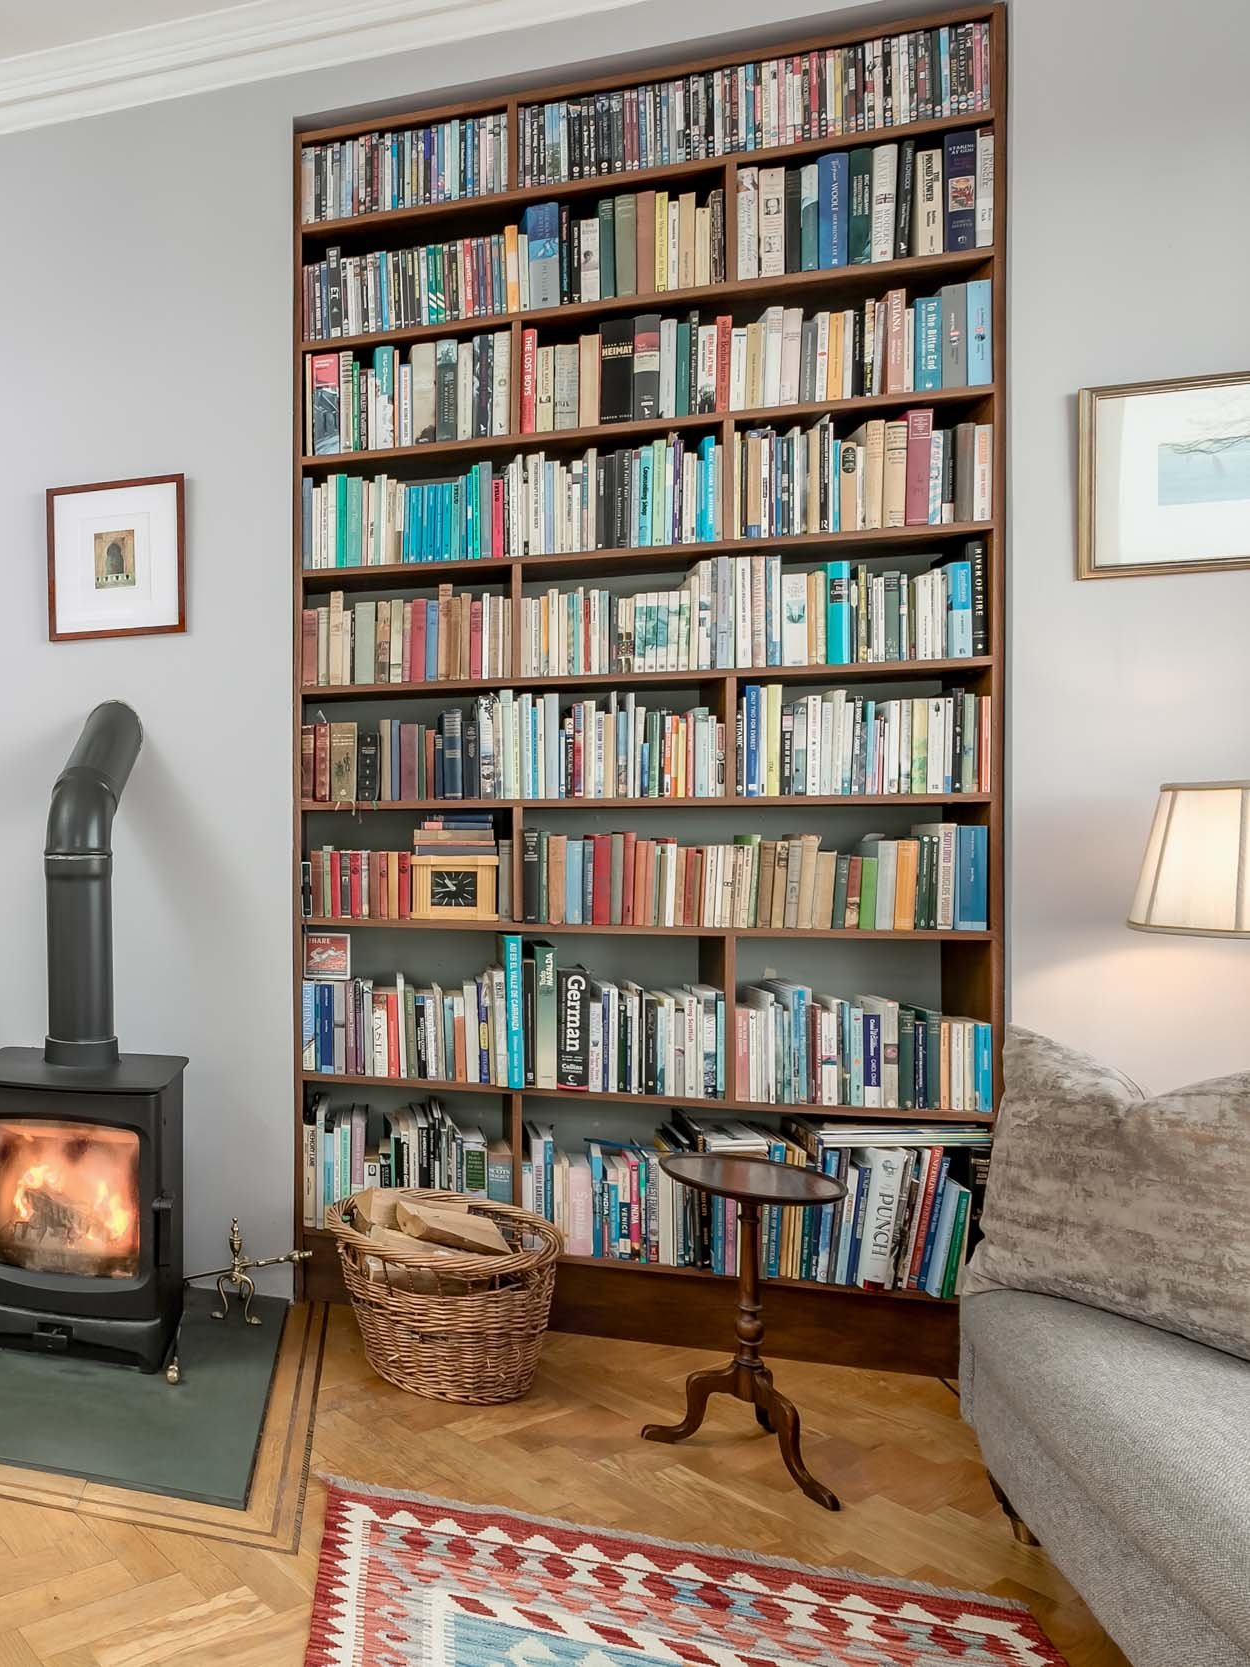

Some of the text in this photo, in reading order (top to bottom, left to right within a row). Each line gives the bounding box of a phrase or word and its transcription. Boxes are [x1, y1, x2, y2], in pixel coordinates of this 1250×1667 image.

[925, 152, 934, 203] PROUD TOWER
[933, 171, 941, 183] THE
[830, 182, 839, 212] WOOLF
[892, 293, 902, 333] TATIANA
[602, 345, 633, 357] HEIMAT
[720, 340, 730, 362] Berlin
[927, 302, 938, 370] To the Bitter End
[524, 335, 533, 397] THE LOST BOYS
[640, 466, 650, 516] Counselling Shop
[974, 548, 984, 617] RIVER OF FIRE
[942, 831, 952, 864] SCOTLAND
[942, 865, 952, 896] DOUGLAS
[510, 962, 518, 970] EL
[510, 970, 518, 989] VALLE
[545, 953, 554, 986] MAFALDA
[510, 990, 519, 999] DE
[565, 975, 586, 1052] German
[561, 1063, 583, 1071] Collins
[534, 1165, 543, 1215] URBAN GARDENER
[648, 1163, 658, 1222] SOUTHWEST FRANCE
[573, 1191, 588, 1240] Spanish
[631, 1204, 639, 1224] INDIA
[871, 1191, 895, 1258] PUNCH
[769, 1241, 777, 1265] AEGEAN
